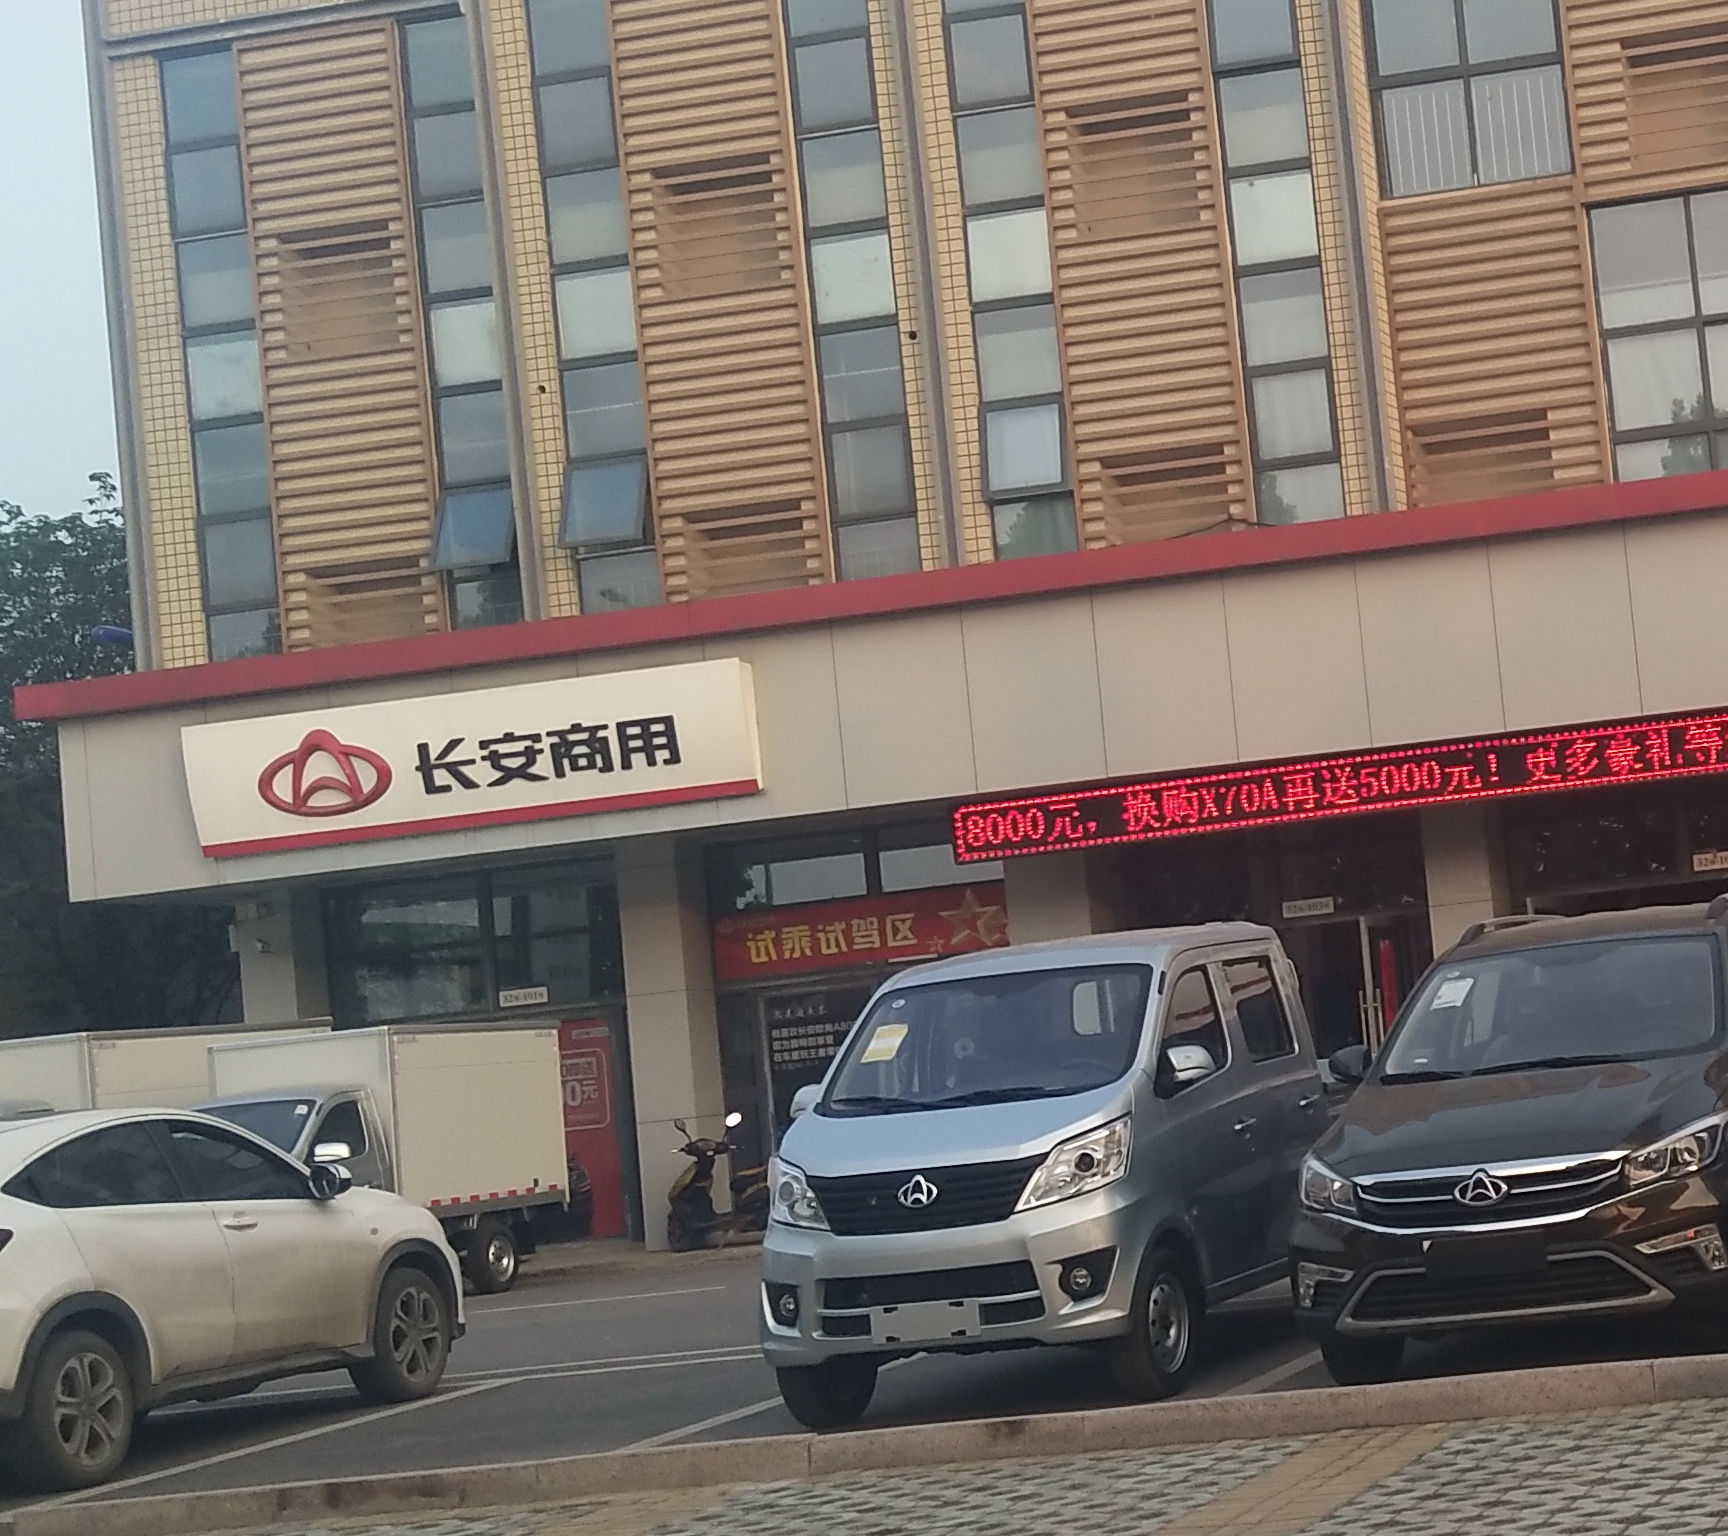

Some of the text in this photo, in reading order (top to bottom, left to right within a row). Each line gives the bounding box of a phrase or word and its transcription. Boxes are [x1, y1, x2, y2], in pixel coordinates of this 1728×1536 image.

[415, 715, 681, 794] 长安商用
[747, 913, 917, 964] 试乘试驾区
